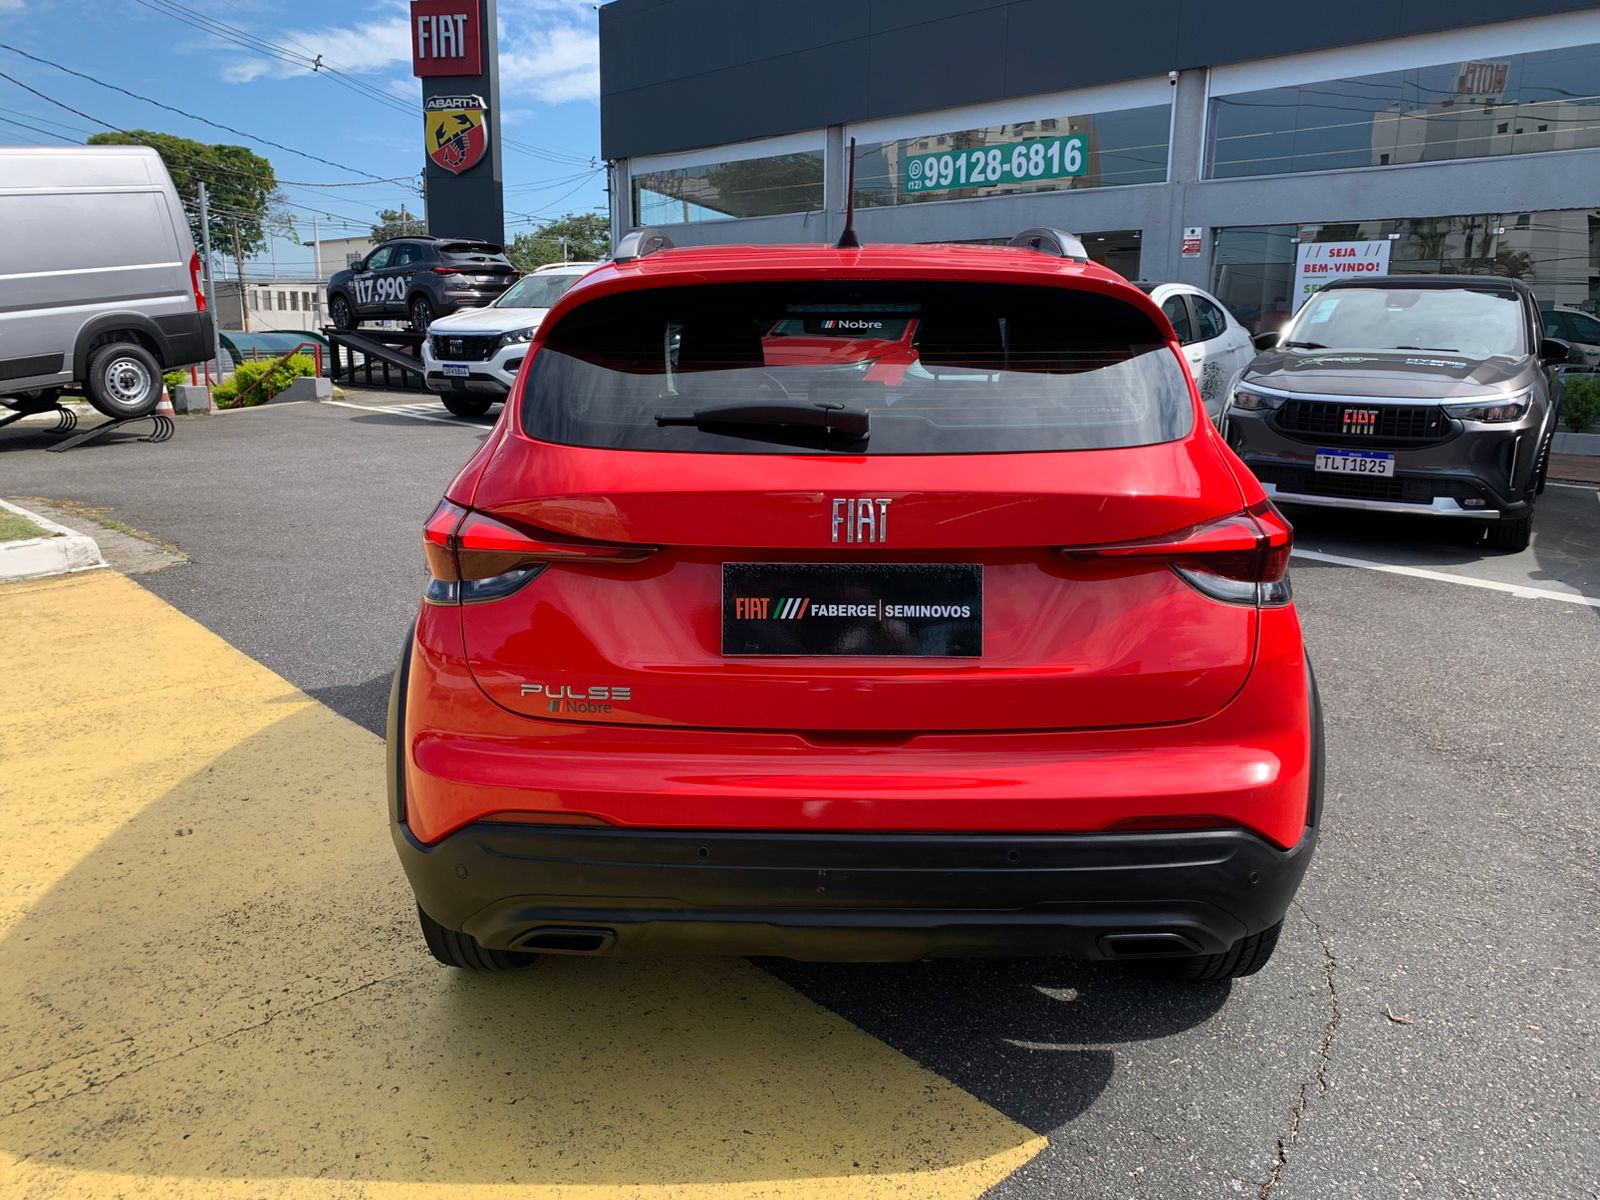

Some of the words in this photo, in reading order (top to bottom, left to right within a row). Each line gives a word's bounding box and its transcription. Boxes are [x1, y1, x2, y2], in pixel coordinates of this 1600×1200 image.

[417, 14, 467, 58] FIAT
[427, 99, 479, 108] ABARTH
[908, 180, 922, 190] (12)
[924, 138, 1082, 187] 99128-6816
[1329, 248, 1356, 258] SEJA
[1303, 262, 1380, 273] BEM-VINDO!
[354, 276, 406, 303] 117.990
[838, 320, 882, 329] Nobre
[1342, 409, 1379, 435] FIAT
[1323, 456, 1387, 474] TLT1B25
[832, 498, 892, 543] FIAT
[736, 598, 770, 619] FIAT
[811, 604, 876, 617] FABERGE
[885, 605, 971, 618] SEMINOVOS
[520, 683, 631, 700] PULSE
[566, 700, 612, 713] Nobre
